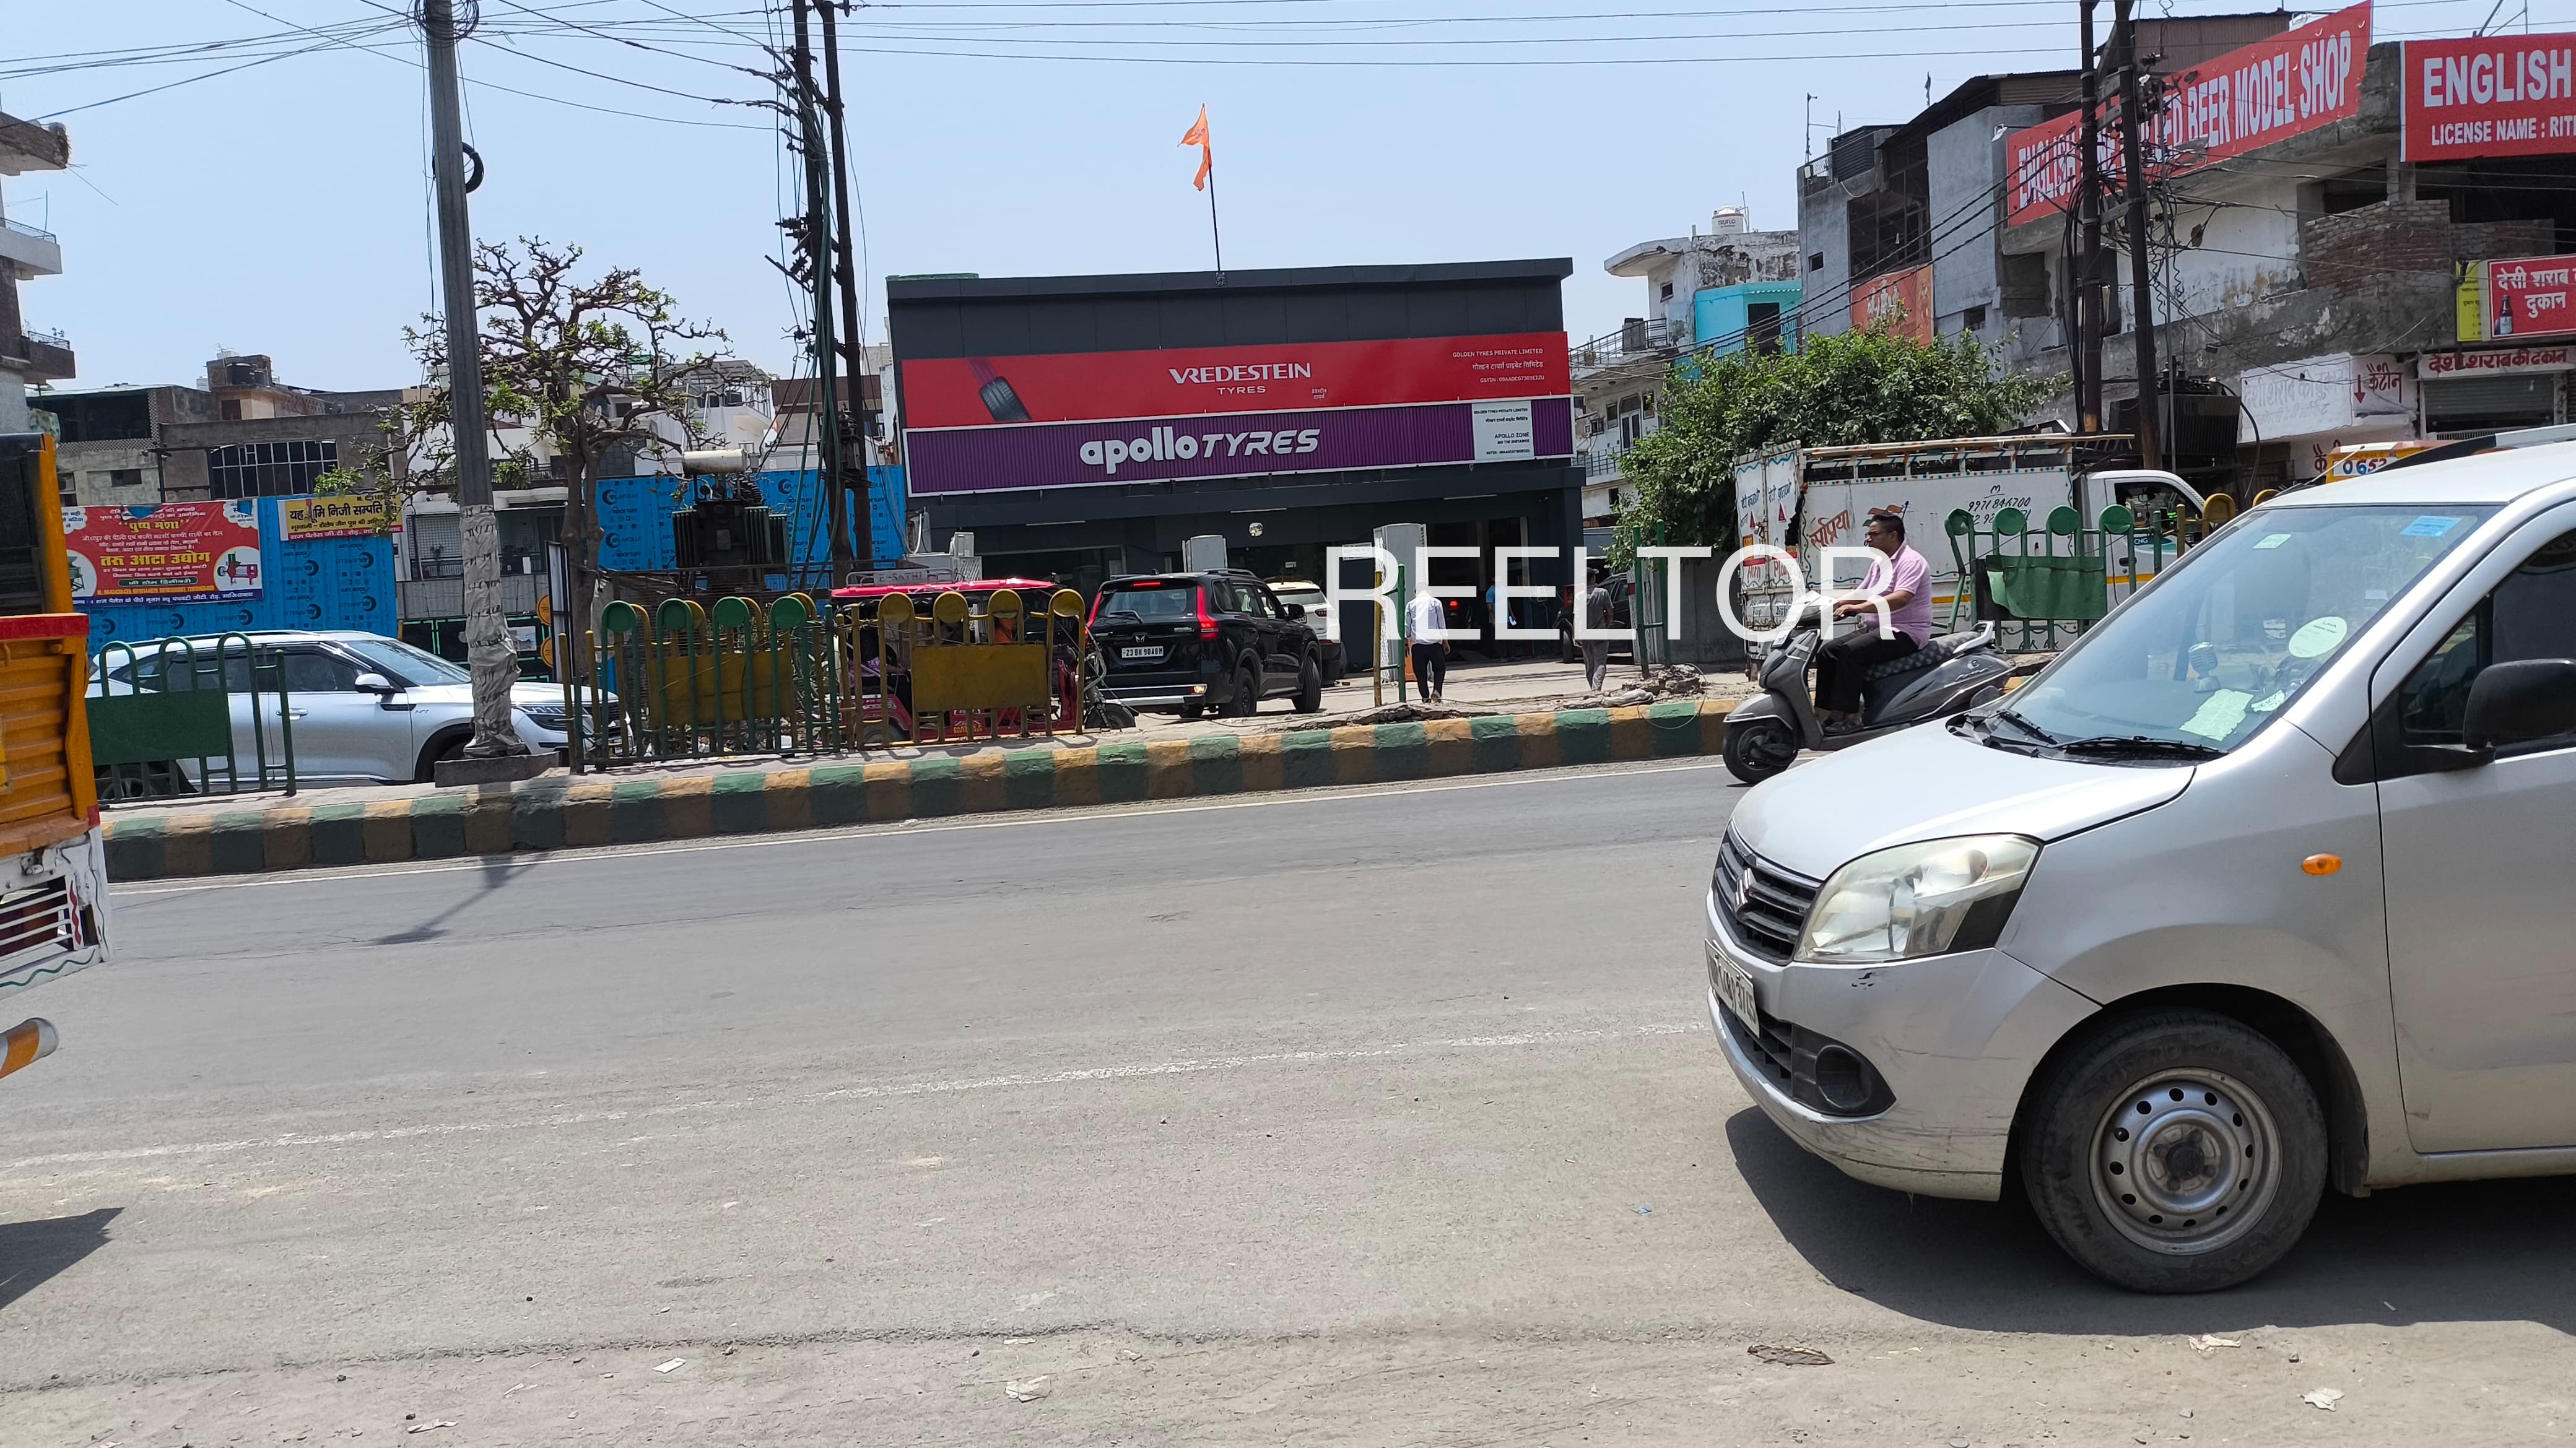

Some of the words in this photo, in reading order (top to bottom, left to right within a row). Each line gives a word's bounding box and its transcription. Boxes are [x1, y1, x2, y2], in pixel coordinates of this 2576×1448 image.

[2188, 75, 2230, 149] BEER
[2235, 52, 2294, 139] MODEL
[2300, 30, 2351, 119] SHOP
[2424, 49, 2572, 108] ENGLISH
[2432, 121, 2492, 145] LICENSE
[2496, 118, 2537, 141] NAME
[2497, 266, 2526, 290] देसी
[2530, 269, 2569, 287] शराब
[2525, 292, 2567, 318] दुकान
[1168, 362, 1312, 384] VREDESTEIN
[1217, 385, 1266, 396] TYRES
[1080, 426, 1198, 475] apollo
[1201, 428, 1320, 458] TYRES
[289, 510, 303, 521] यह
[328, 503, 350, 516] निजी
[129, 554, 167, 566] आटा
